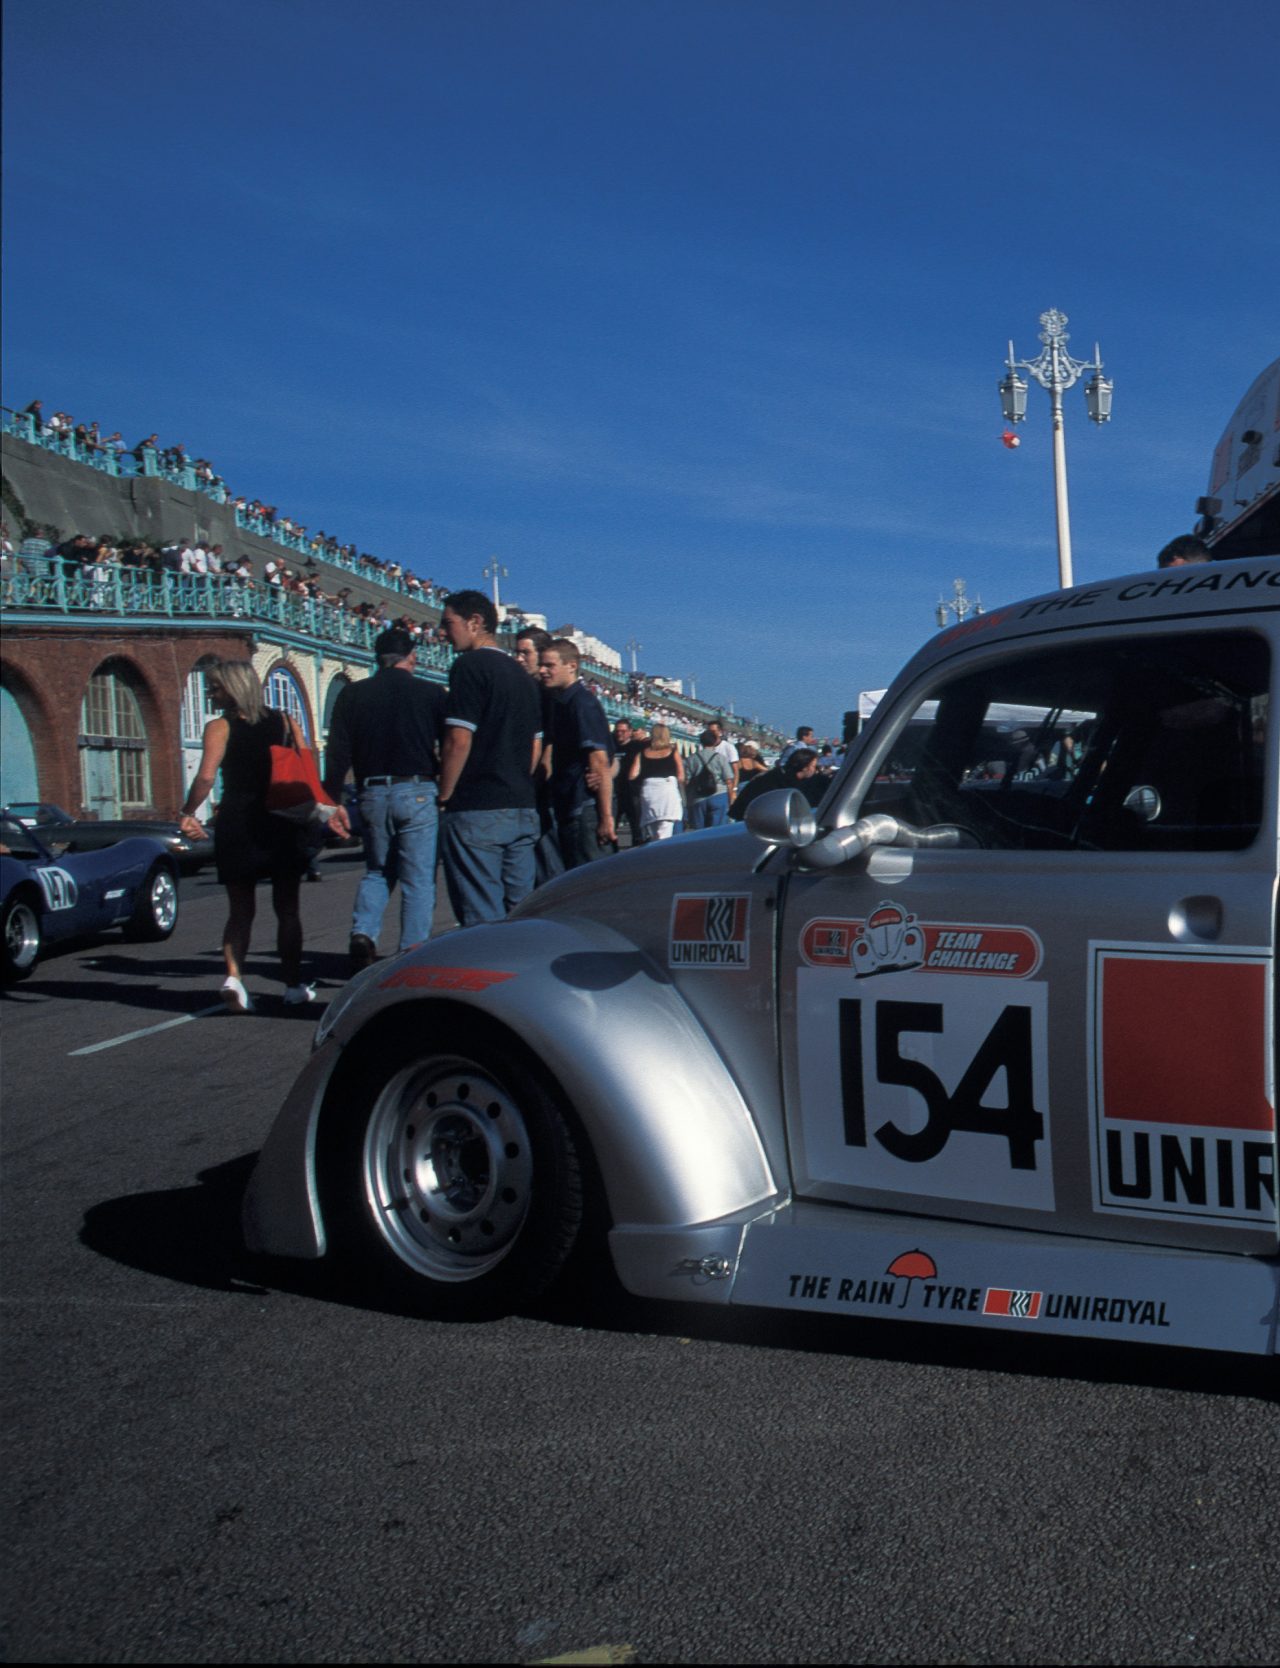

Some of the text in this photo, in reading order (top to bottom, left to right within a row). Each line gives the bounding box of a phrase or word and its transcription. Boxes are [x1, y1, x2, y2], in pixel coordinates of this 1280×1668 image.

[1018, 587, 1111, 620] THE
[672, 943, 745, 964] UNIROYAL
[935, 931, 983, 949] TEAM
[927, 949, 1020, 971] CHALLENGE
[838, 998, 1045, 1171] 154
[788, 1274, 1171, 1327] THE RAIN TYRE UNIROYAL
